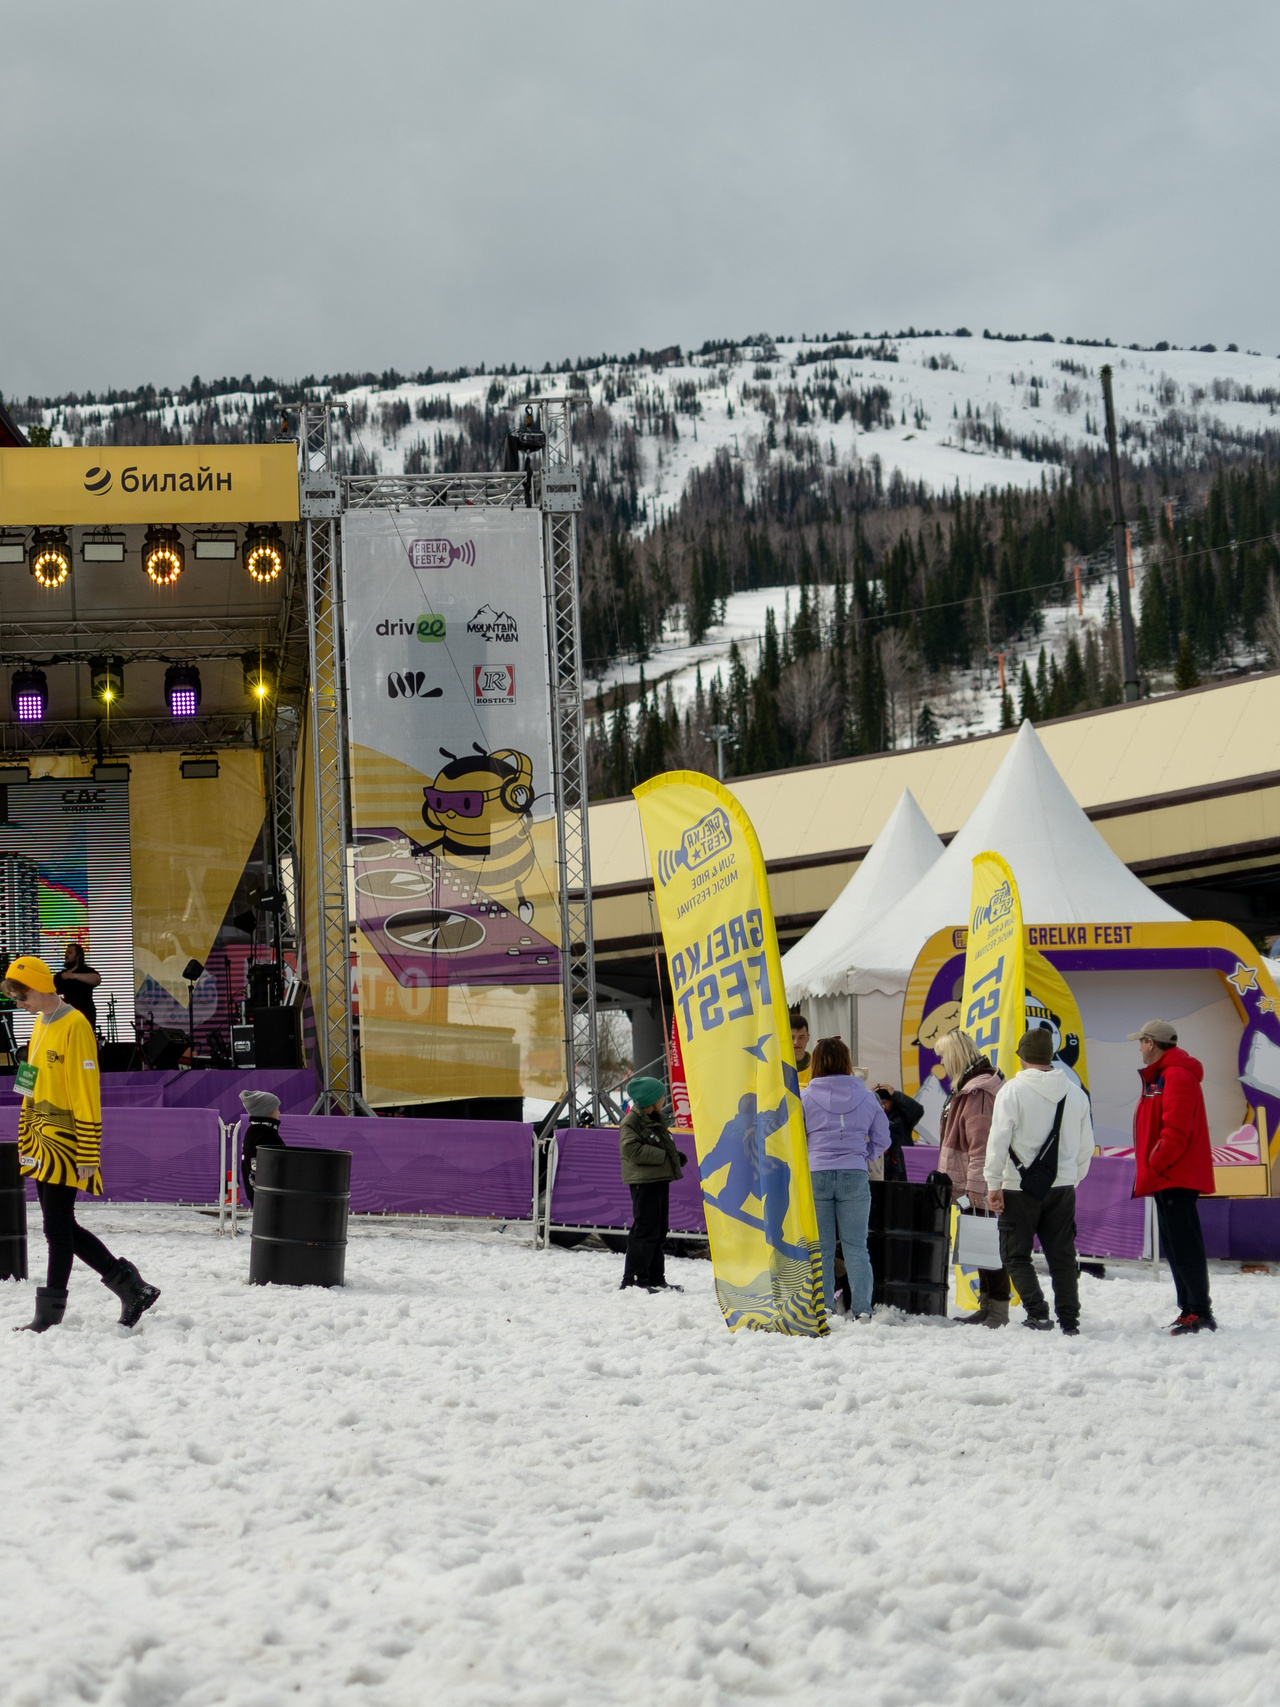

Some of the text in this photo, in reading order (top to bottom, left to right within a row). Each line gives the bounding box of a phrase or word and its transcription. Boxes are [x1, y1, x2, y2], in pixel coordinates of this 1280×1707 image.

[120, 466, 232, 493] билайн
[414, 543, 448, 554] GRELKA
[415, 555, 437, 565] FEST
[375, 618, 446, 638] drivee
[1029, 925, 1133, 946] GRELKA FEST
